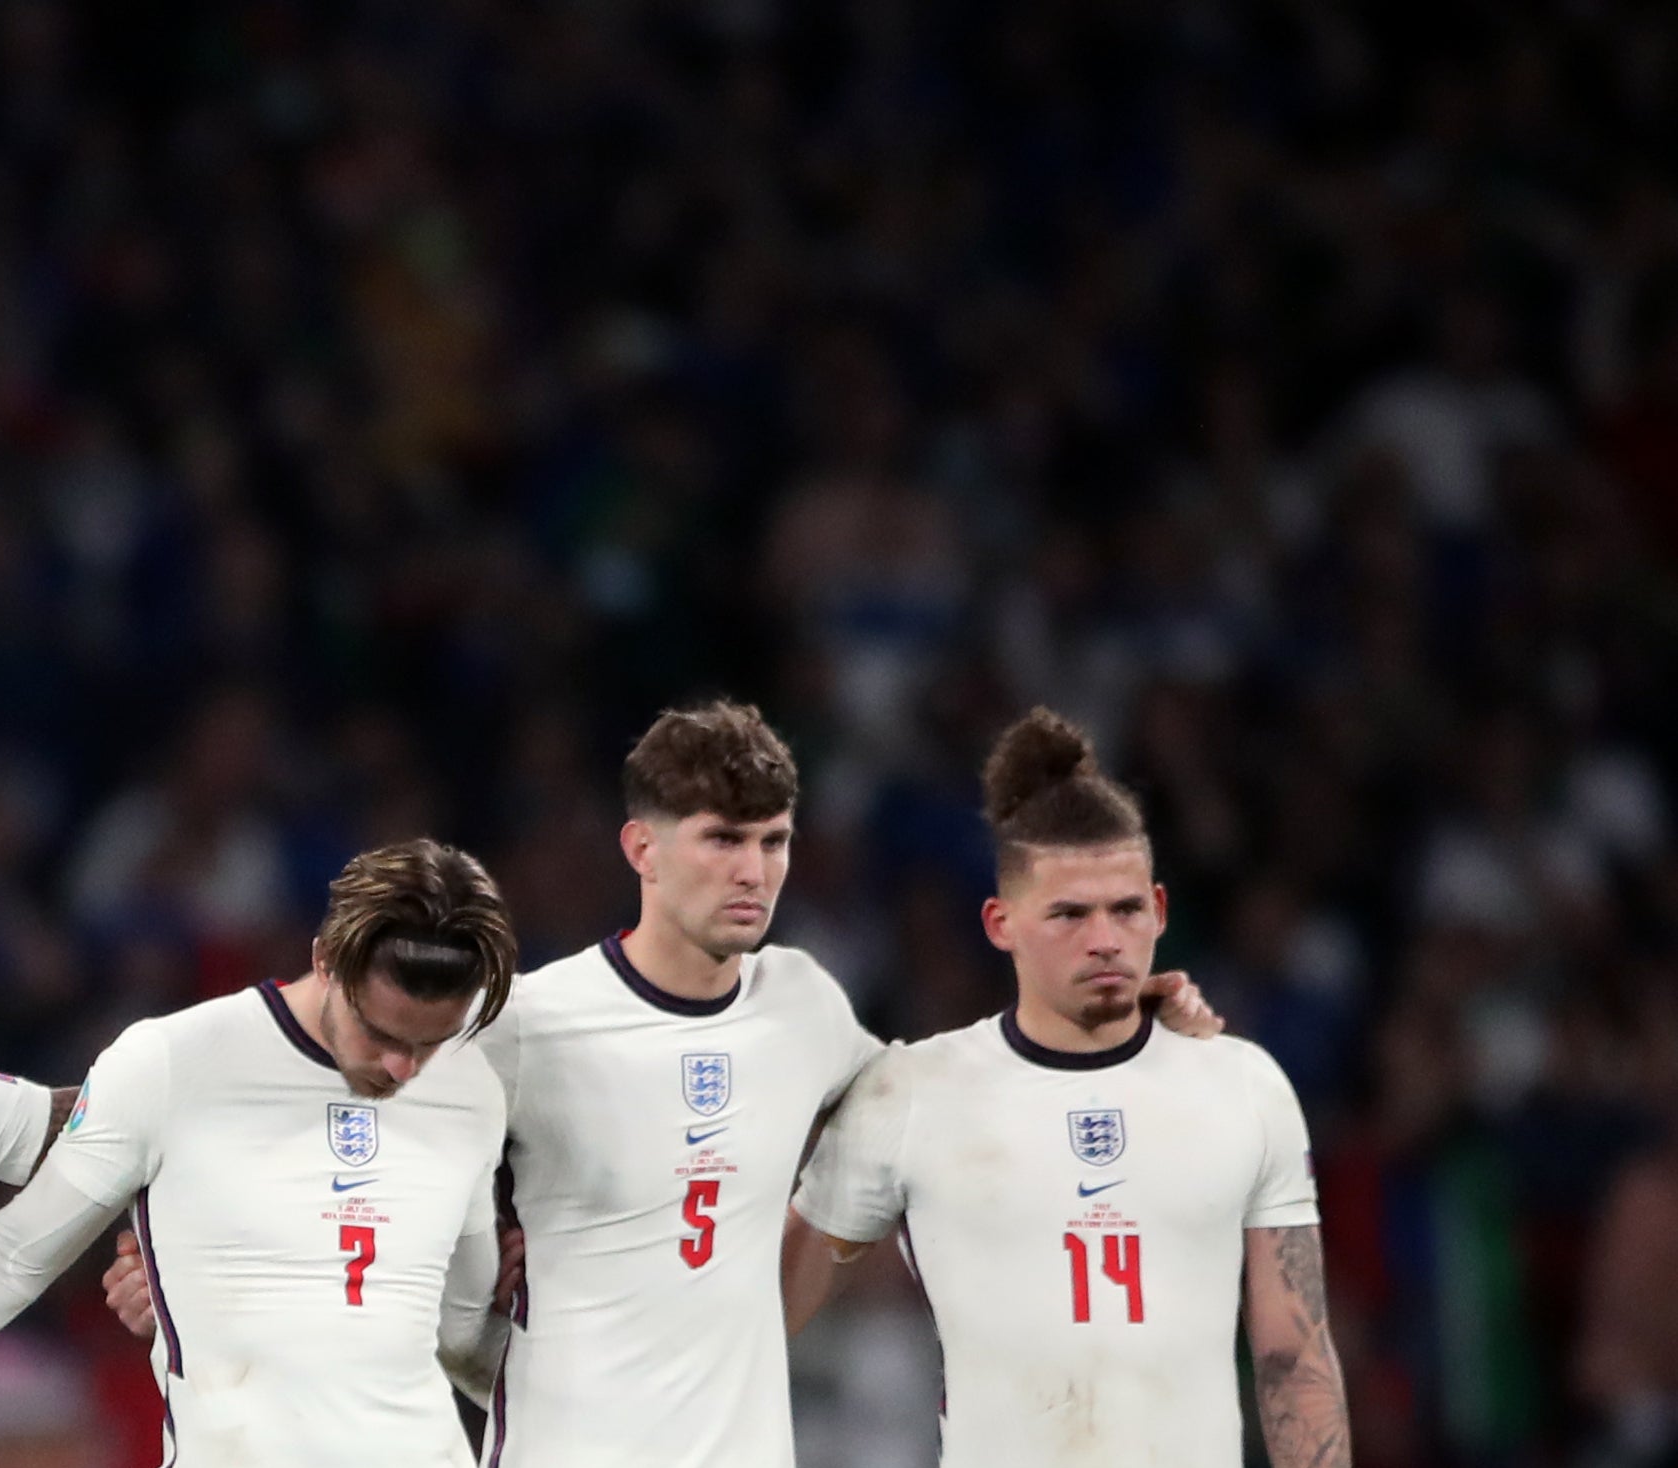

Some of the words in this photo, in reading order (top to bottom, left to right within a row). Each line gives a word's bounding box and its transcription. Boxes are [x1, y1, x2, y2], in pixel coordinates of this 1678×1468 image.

[338, 1223, 378, 1308] 7
[678, 1178, 722, 1270] 5
[1062, 1231, 1147, 1325] 14
